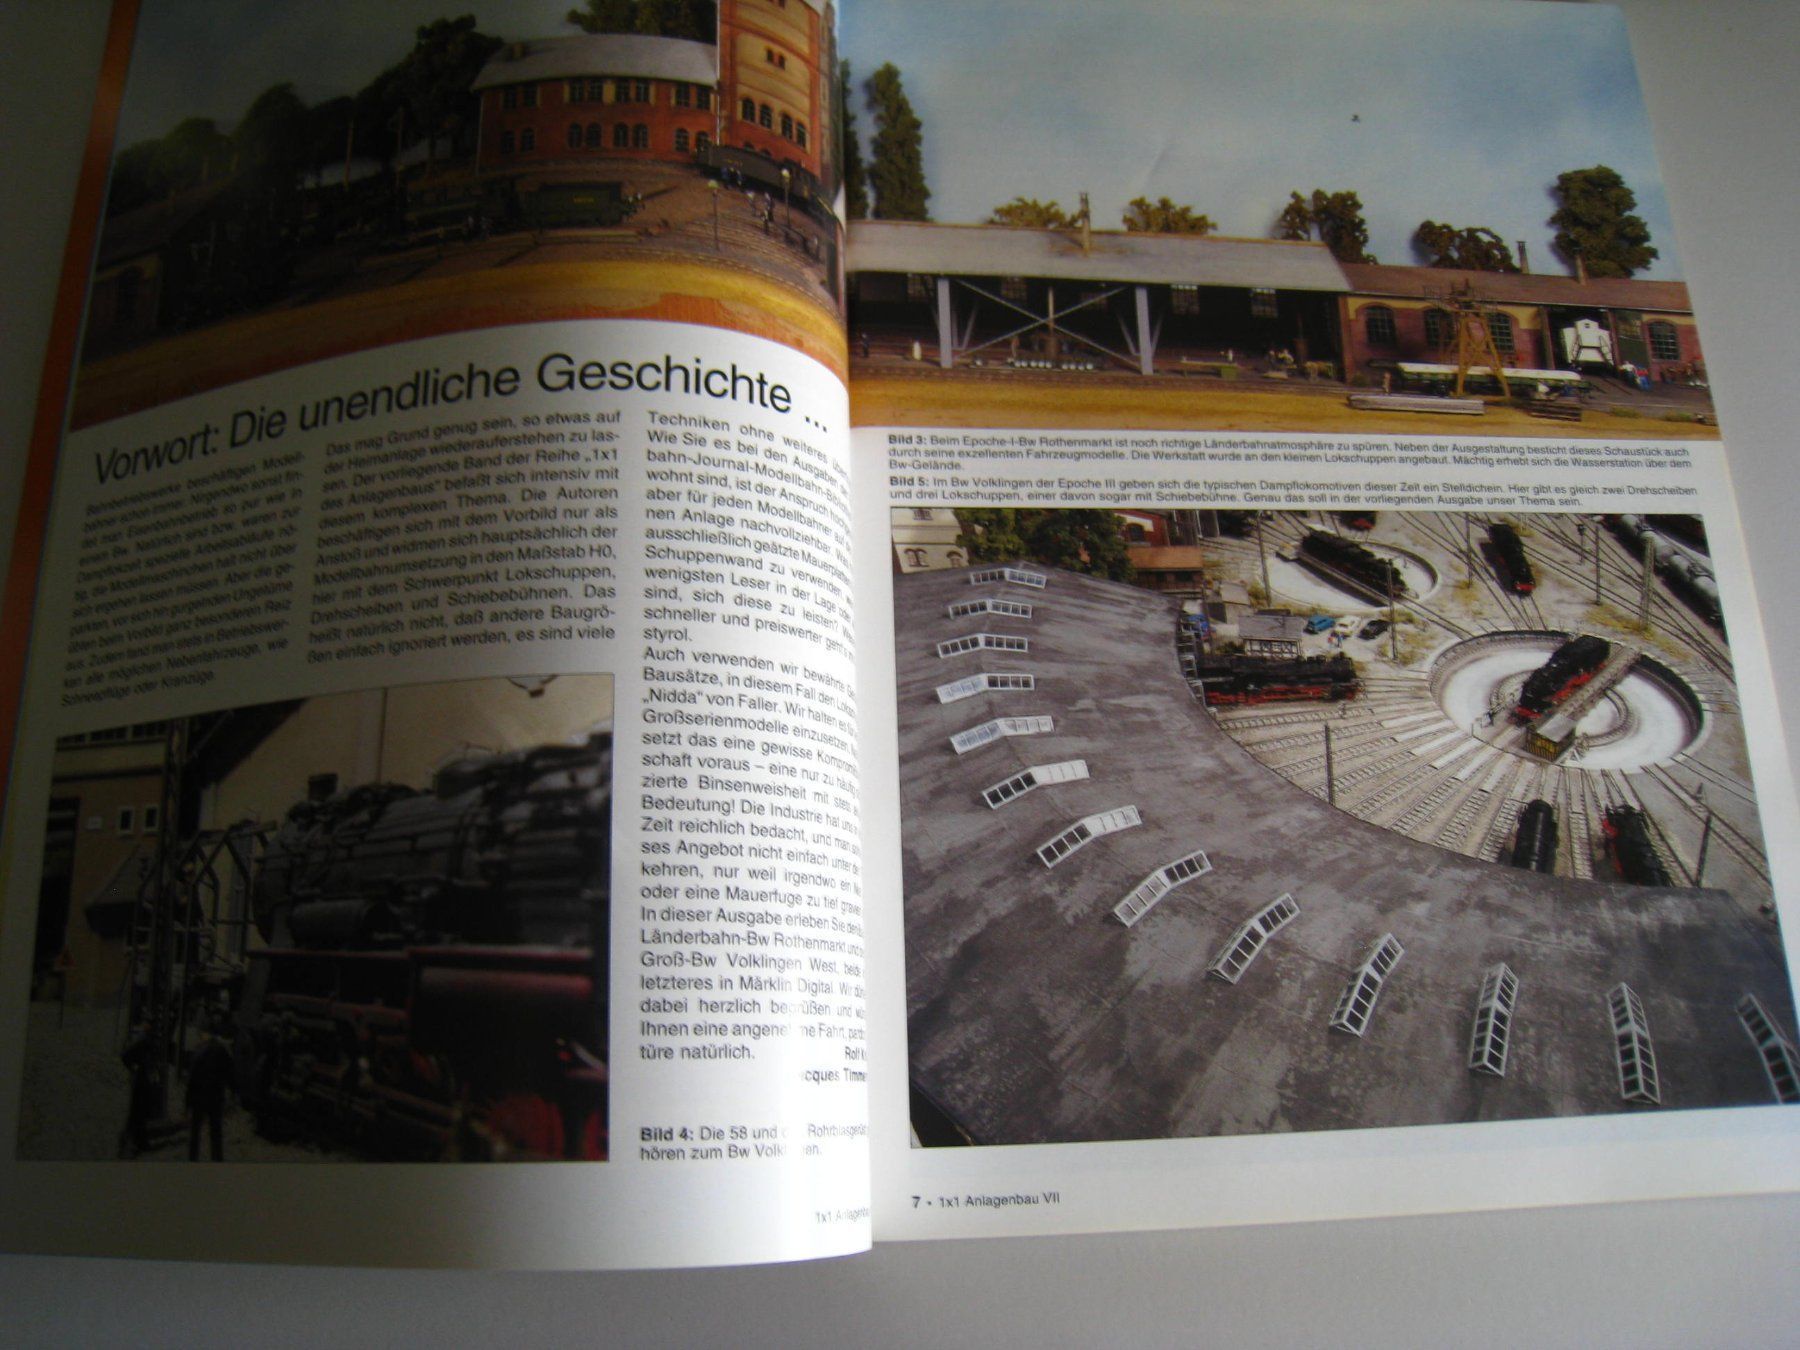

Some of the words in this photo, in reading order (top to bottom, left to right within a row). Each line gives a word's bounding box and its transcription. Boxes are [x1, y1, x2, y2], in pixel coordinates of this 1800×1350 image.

[95, 424, 219, 485] Vorwort:
[229, 405, 287, 449] Die
[299, 361, 521, 431] unendliche
[537, 353, 792, 414] Geschichte
[481, 417, 516, 431] sein,
[522, 415, 540, 426] so
[545, 412, 591, 425] etwas
[595, 410, 620, 423] auf
[648, 410, 729, 430] Techniken
[739, 424, 774, 441] ohne
[569, 432, 587, 442] zu
[591, 429, 619, 441] las-
[647, 429, 677, 443] Wie
[682, 431, 707, 447] Sie
[713, 438, 731, 450] es
[737, 439, 758, 455] bei
[763, 447, 787, 463] den
[888, 433, 913, 444] Bild
[915, 434, 926, 445] 3:
[930, 434, 960, 445] Beim
[1038, 436, 1112, 447] Rothenmarkt
[1115, 438, 1128, 447] ist
[1130, 438, 1158, 447] noch
[1160, 438, 1201, 450] richtige
[1337, 442, 1350, 450] zu
[1352, 442, 1393, 453] spüren.
[1394, 442, 1430, 452] Neben
[1431, 443, 1448, 452] der
[1451, 443, 1525, 456] Ausgestaltung
[1526, 445, 1567, 454] besticht
[1568, 445, 1602, 455] dieses
[1603, 446, 1662, 456] Schaustück
[1663, 448, 1689, 457] auch
[535, 449, 580, 463] Reihe
[585, 448, 617, 462] „1x1
[888, 447, 921, 457] durch
[924, 449, 955, 457] seine
[957, 448, 1024, 459] exzellenten
[1025, 448, 1129, 460] Fahrzeugmodelle.
[1131, 449, 1150, 460] Die
[1151, 450, 1206, 460] Werkstatt
[1207, 451, 1242, 461] wurde
[1324, 453, 1396, 464] Lokschuppen
[1452, 454, 1494, 467] Mächtig
[1570, 457, 1643, 468] Wasserstation
[530, 467, 590, 482] intensiv
[595, 467, 619, 479] mit
[646, 469, 693, 483] wohnt
[696, 473, 731, 489] sind,
[735, 478, 751, 492] ist
[754, 482, 776, 496] der
[521, 487, 547, 502] Die
[556, 486, 618, 499] Autoren
[889, 475, 914, 486] Bild
[918, 476, 928, 486] 5:
[933, 477, 947, 486] Im
[950, 476, 968, 487] Bw
[1035, 478, 1054, 488] der
[1058, 478, 1101, 490] Epoche
[1105, 479, 1115, 488] III
[1119, 479, 1154, 491] geben
[1157, 480, 1180, 489] sich
[1183, 479, 1200, 489] die
[1203, 480, 1256, 493] typischen
[1259, 479, 1361, 492] Dampflokomotiven
[1364, 481, 1396, 491] dieser
[1399, 481, 1420, 492] Zeit
[1422, 484, 1439, 492] ein
[1441, 482, 1502, 493] Stelldichein.
[1507, 484, 1532, 493] Hier
[1532, 484, 1551, 495] gibt
[1554, 486, 1566, 494] es
[1569, 485, 1599, 496] gleich
[1626, 485, 1697, 495] Drehscheiben
[646, 487, 681, 501] aber
[687, 489, 707, 503] für
[712, 495, 752, 510] jeden
[890, 490, 912, 498] und
[915, 489, 937, 498] drei
[942, 490, 1023, 501] Lokschuppen,
[1027, 492, 1055, 500] einer
[1060, 492, 1095, 500] davon
[1099, 493, 1130, 502] sogar
[1135, 492, 1151, 500] mit
[1243, 492, 1280, 502] Genau
[1284, 493, 1304, 502] das
[1308, 493, 1326, 502] soll
[1343, 494, 1360, 502] der
[1364, 494, 1433, 505] vorliegenden
[1437, 495, 1483, 506] Ausgabe
[1518, 494, 1555, 505] Thema
[1558, 495, 1583, 505] sein.
[503, 506, 557, 522] Vorbild
[563, 508, 589, 519] nur
[594, 505, 618, 518] als
[645, 508, 675, 520] nen
[682, 508, 734, 526] Anlage
[505, 565, 616, 581] Lokschuppen,
[644, 567, 724, 584] wenigsten
[731, 572, 770, 591] Leser
[776, 583, 786, 594] in
[644, 586, 681, 601] sind,
[692, 589, 724, 603] sich
[733, 593, 772, 611] diese
[780, 603, 794, 616] zu
[514, 629, 535, 641] es
[538, 625, 572, 640] sind
[577, 625, 615, 639] viele
[643, 646, 684, 661] Auch
[692, 652, 774, 671] verwenden
[780, 663, 798, 675] wir
[642, 687, 703, 704] „Nidda“
[705, 694, 734, 706] von
[738, 693, 781, 712] Faller.
[642, 732, 681, 745] setzt
[688, 732, 717, 747] das
[723, 736, 755, 751] eine
[641, 794, 735, 816] Bedeutung!
[741, 798, 765, 815] Die
[770, 803, 822, 824] Industrie
[641, 816, 672, 831] Zeit
[679, 819, 745, 834] reichlich
[640, 842, 670, 854] ses
[676, 839, 744, 859] Angebot
[748, 845, 782, 859] nicht
[640, 884, 679, 899] oder
[684, 885, 720, 900] eine
[640, 929, 770, 946] Länderbahn-Bw
[640, 950, 716, 967] Groß-Bw
[639, 1044, 674, 1060] türe
[680, 1044, 755, 1059] natürlich.
[640, 1126, 673, 1141] Bild
[678, 1126, 693, 1140] 4:
[700, 1125, 725, 1140] Die
[729, 1125, 747, 1140] 58
[752, 1125, 777, 1139] und
[640, 1147, 685, 1160] hören
[690, 1147, 722, 1159] zum
[727, 1143, 750, 1158] Bw
[911, 1195, 921, 1208] 7
[939, 1196, 959, 1208] 1x1
[964, 1193, 1039, 1208] Anlagenbau
[1042, 1191, 1060, 1204] VII
